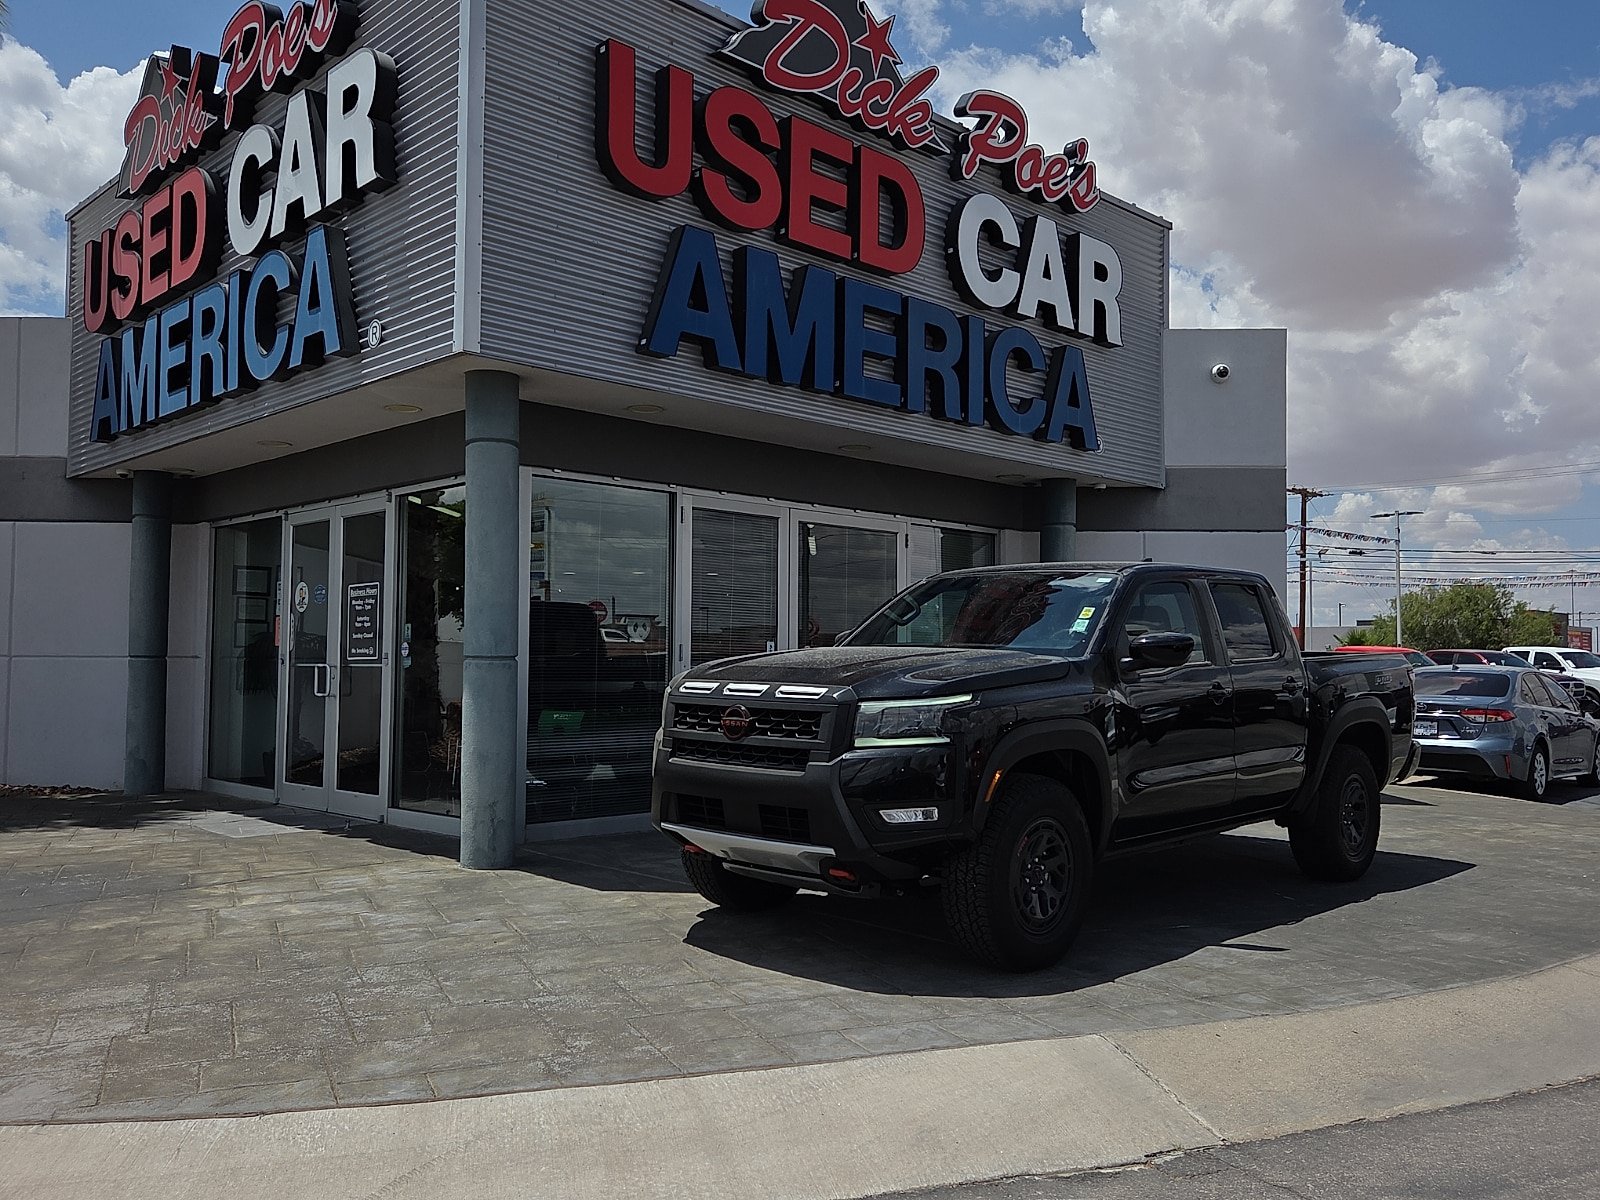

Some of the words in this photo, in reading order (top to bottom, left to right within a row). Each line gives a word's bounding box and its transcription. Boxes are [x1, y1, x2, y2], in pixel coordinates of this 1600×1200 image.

[85, 167, 207, 333] USED
[227, 48, 378, 256] CAR
[124, 53, 209, 194] Dick
[220, 0, 338, 131] Poes
[604, 38, 925, 276] USED
[957, 193, 1124, 348] CAR
[763, 0, 939, 148] Dick
[957, 89, 1101, 213] Poe's
[90, 225, 341, 442] AMERICA
[648, 224, 1099, 452] AMERICA
